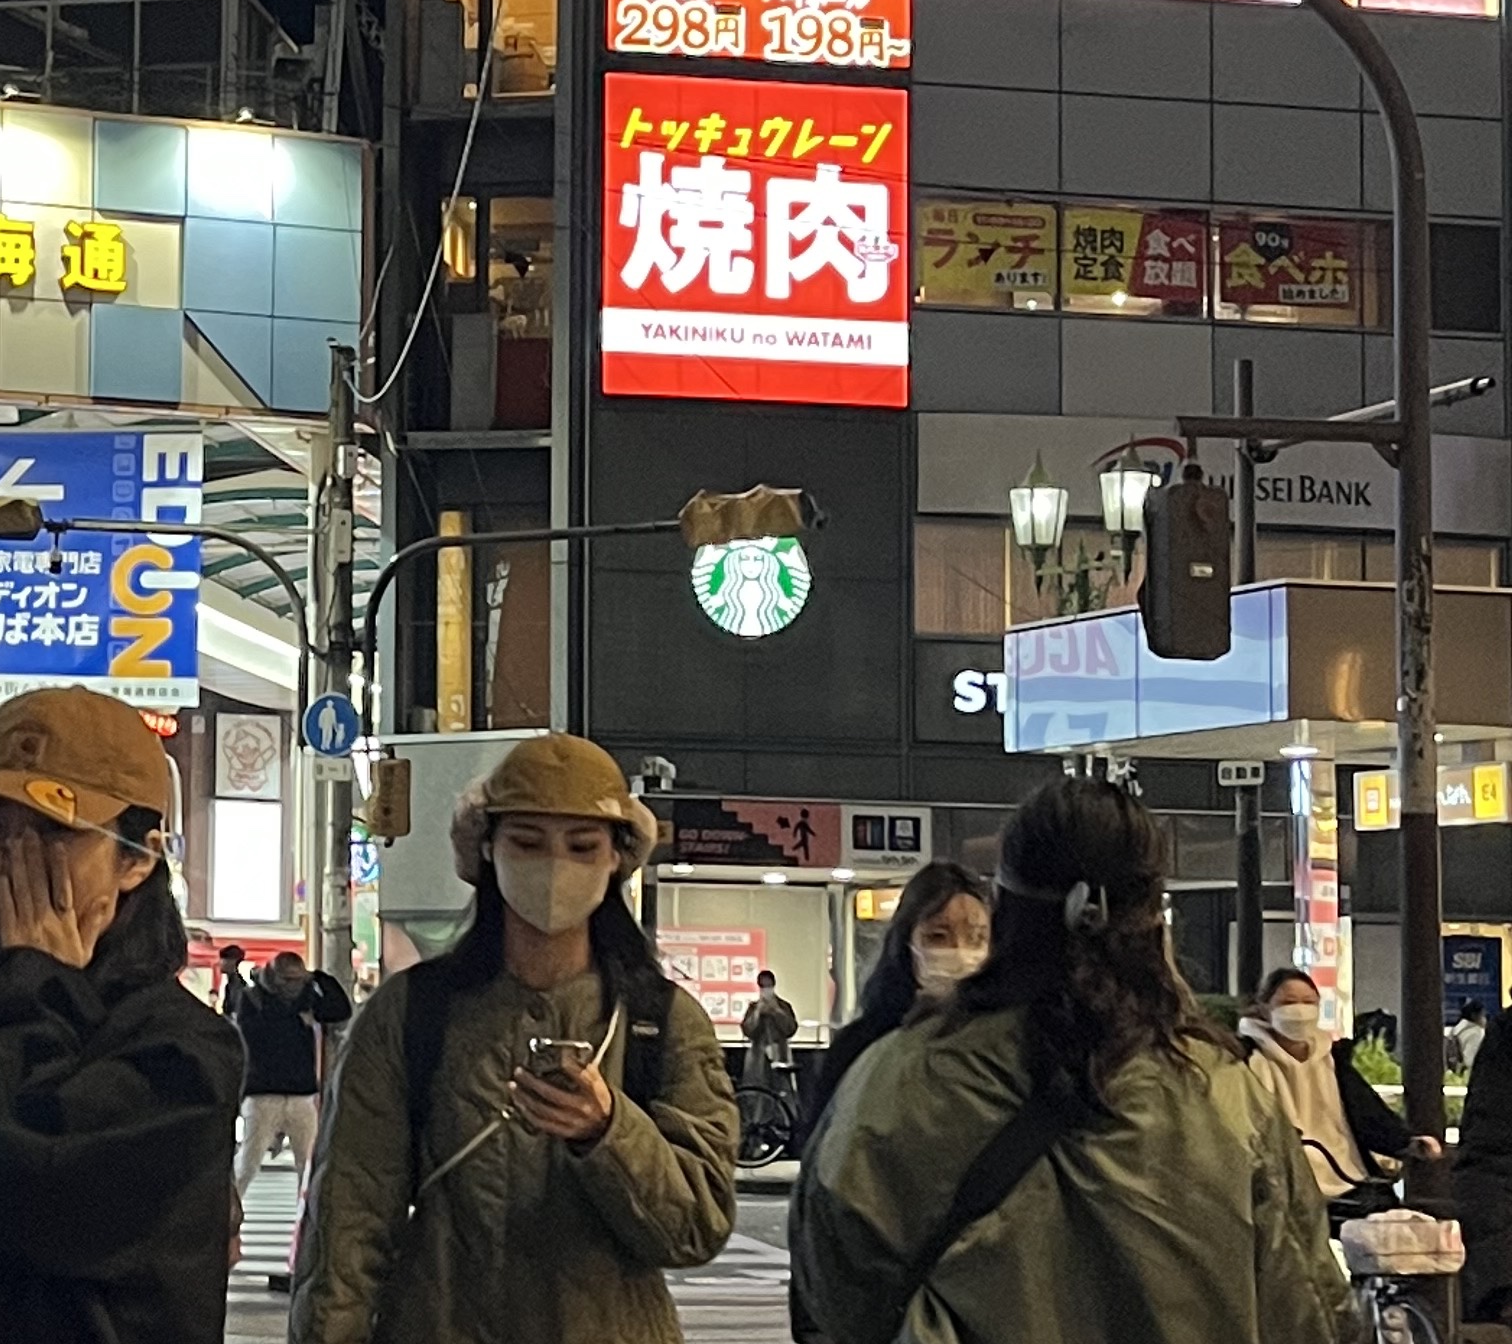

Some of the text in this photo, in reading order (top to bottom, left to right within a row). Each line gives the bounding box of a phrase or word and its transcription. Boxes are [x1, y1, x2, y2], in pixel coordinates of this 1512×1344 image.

[619, 106, 893, 163] トッキュウレーン
[619, 152, 890, 304] 焼肉
[1073, 224, 1125, 254] 焼肉
[1144, 228, 1196, 257] 食べ
[1073, 256, 1127, 282] 定食
[640, 321, 874, 353] YAKINIKU no WATAMI
[1299, 475, 1373, 507] BANK
